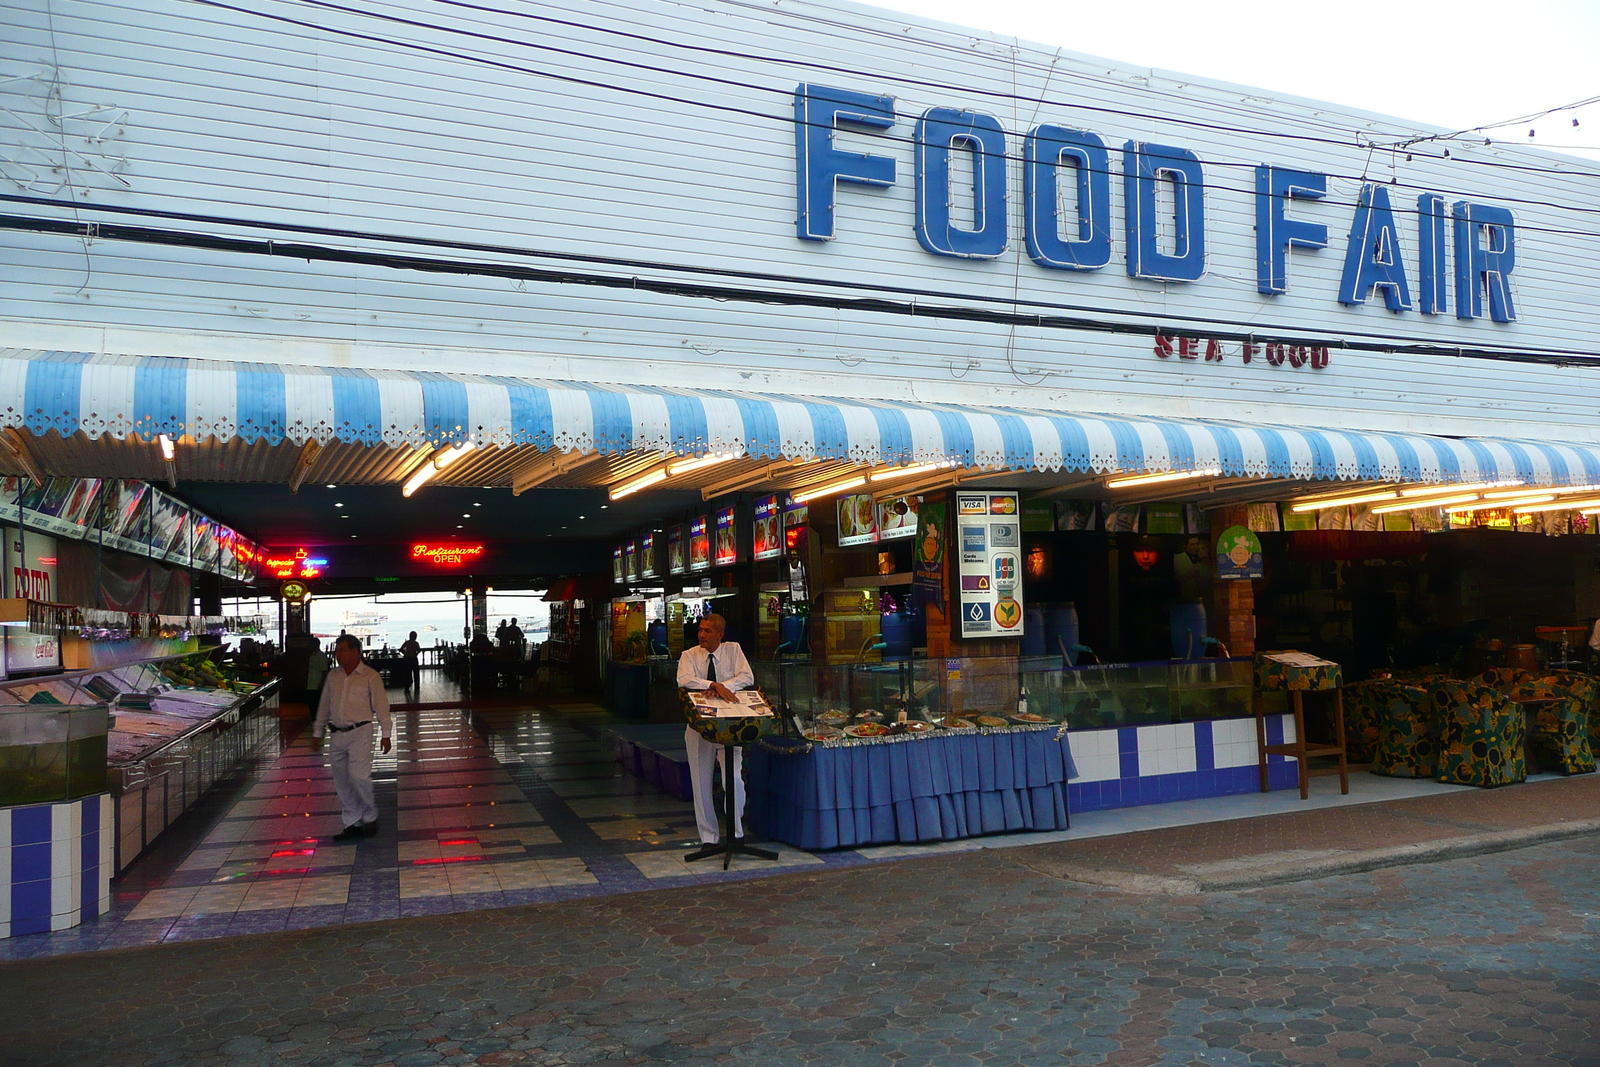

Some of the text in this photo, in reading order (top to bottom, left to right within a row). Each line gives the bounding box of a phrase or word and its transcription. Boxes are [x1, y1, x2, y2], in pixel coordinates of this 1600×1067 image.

[795, 82, 1519, 323] FOOD FAIR
[1154, 335, 1331, 369] SEA FOOD
[413, 545, 483, 557] Restaurant
[433, 554, 461, 563] OPEN
